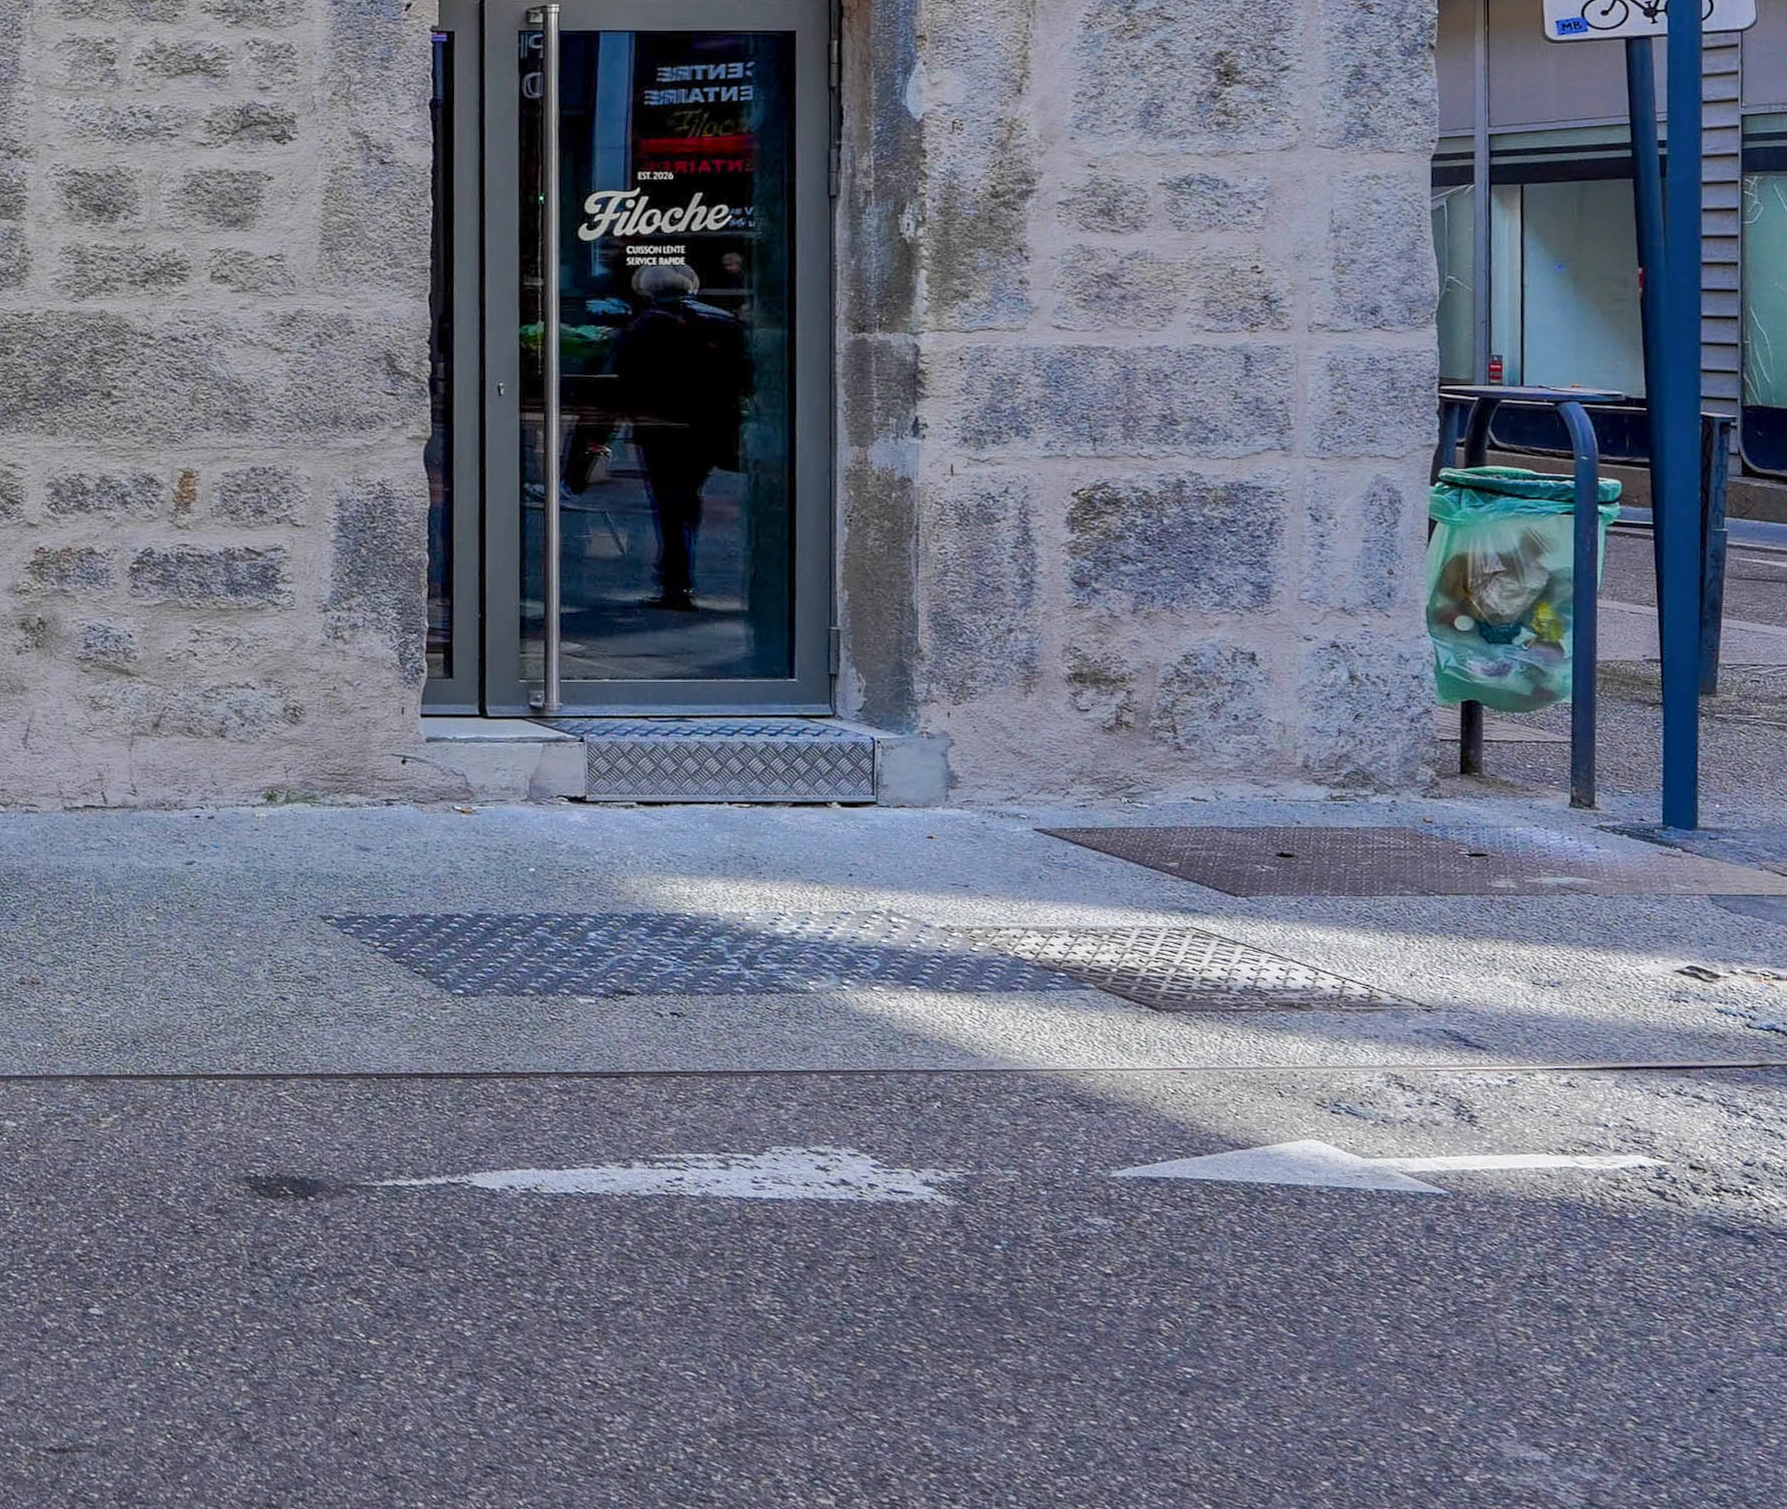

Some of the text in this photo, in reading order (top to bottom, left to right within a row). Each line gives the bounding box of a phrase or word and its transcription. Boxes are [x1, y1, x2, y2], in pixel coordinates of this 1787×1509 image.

[637, 171, 674, 180] EST. 2026
[577, 186, 732, 241] Filoche
[626, 245, 686, 254] CUISSON LENTE
[626, 257, 686, 266] SERVICE RAPIDE
